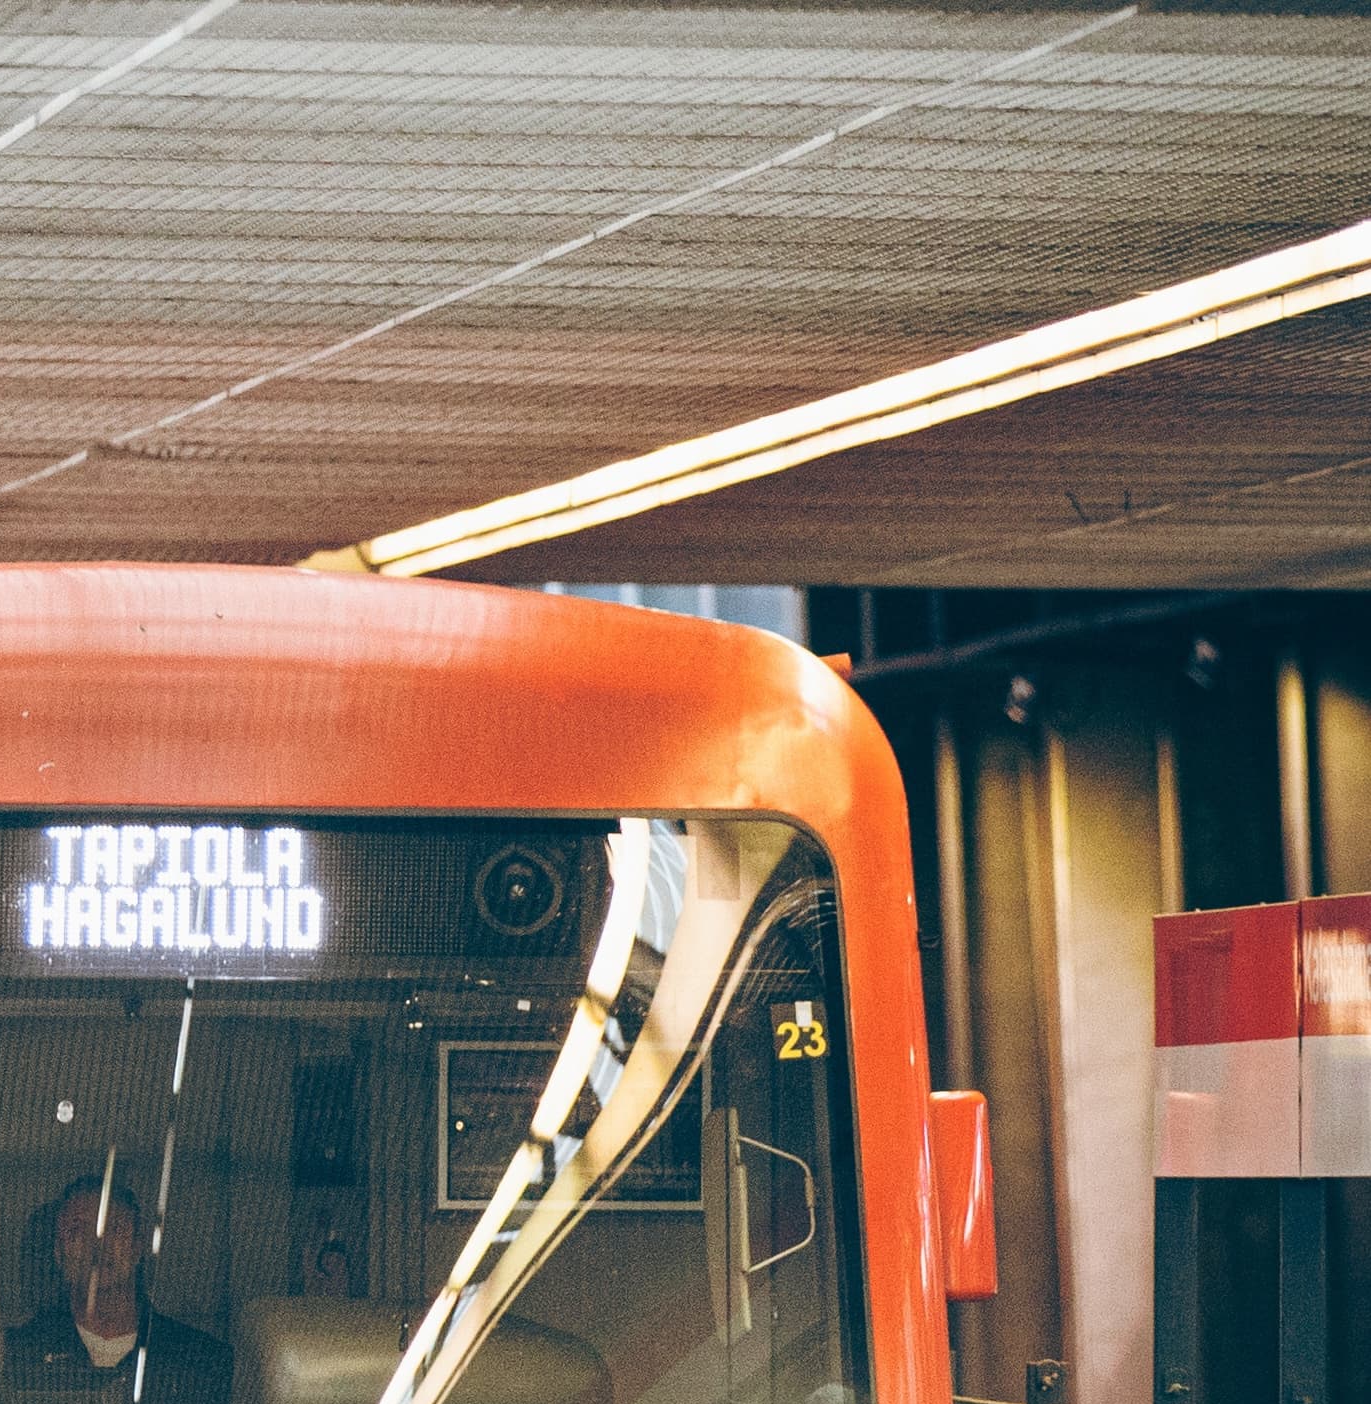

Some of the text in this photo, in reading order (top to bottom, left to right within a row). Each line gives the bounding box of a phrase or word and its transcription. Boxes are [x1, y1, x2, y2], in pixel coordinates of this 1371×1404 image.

[41, 825, 302, 886] TAPIOLA
[26, 885, 323, 950] HAGALUND
[776, 1020, 827, 1060] 23
